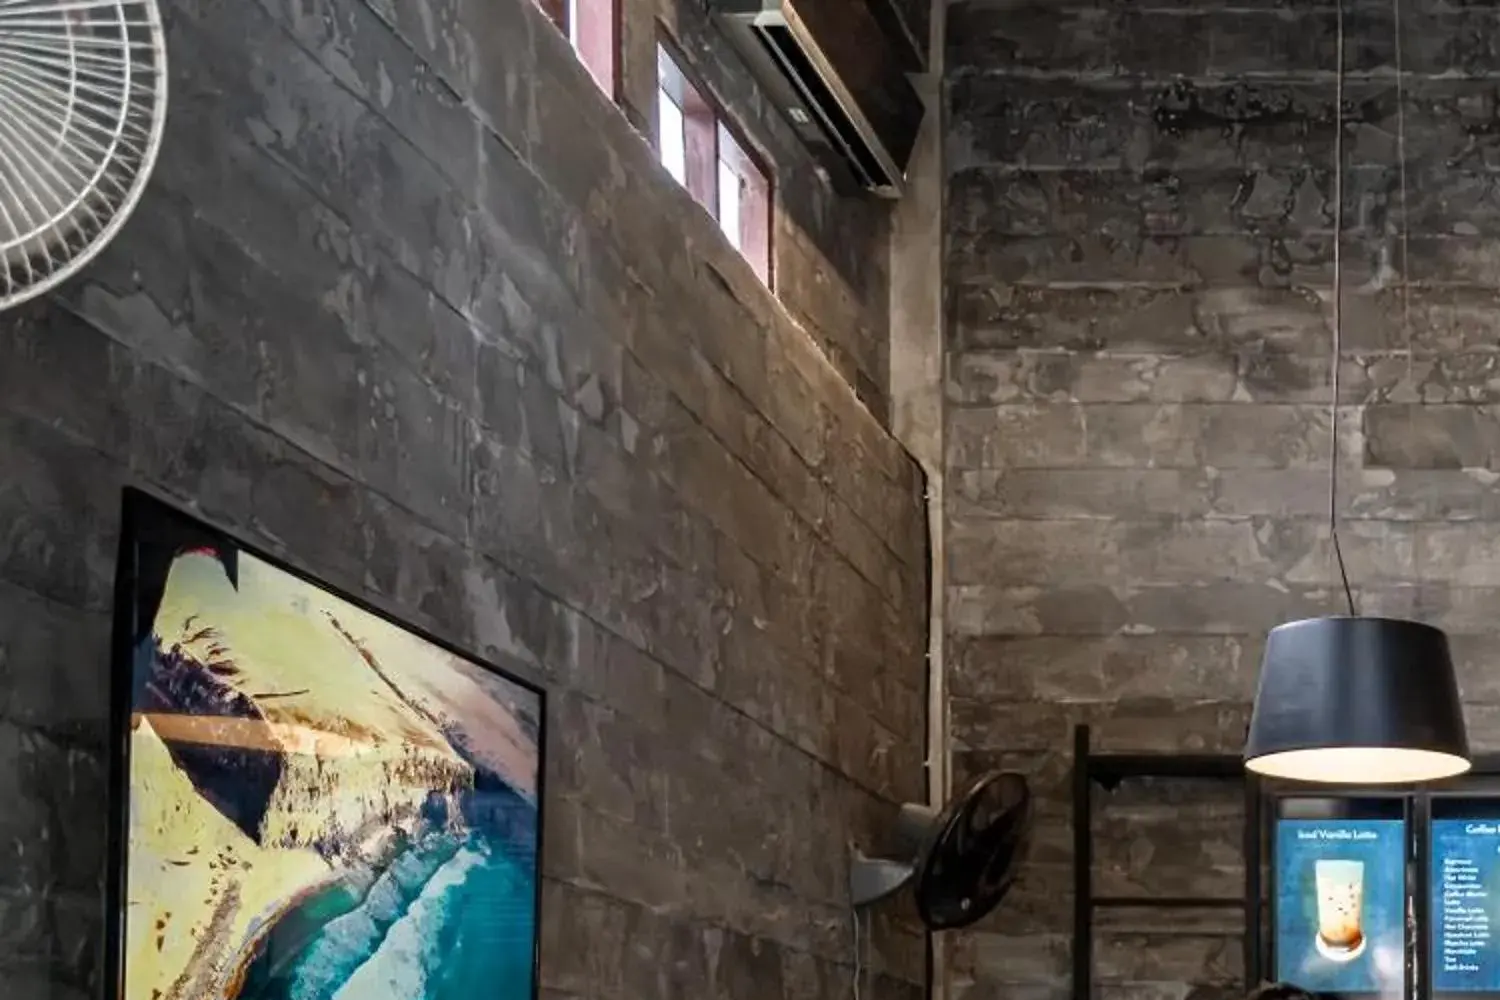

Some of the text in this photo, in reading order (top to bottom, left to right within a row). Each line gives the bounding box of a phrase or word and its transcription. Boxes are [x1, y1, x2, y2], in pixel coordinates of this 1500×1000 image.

[1316, 828, 1352, 840] Vanilla
[1353, 828, 1378, 840] Latte
[1465, 823, 1497, 835] Coffee
